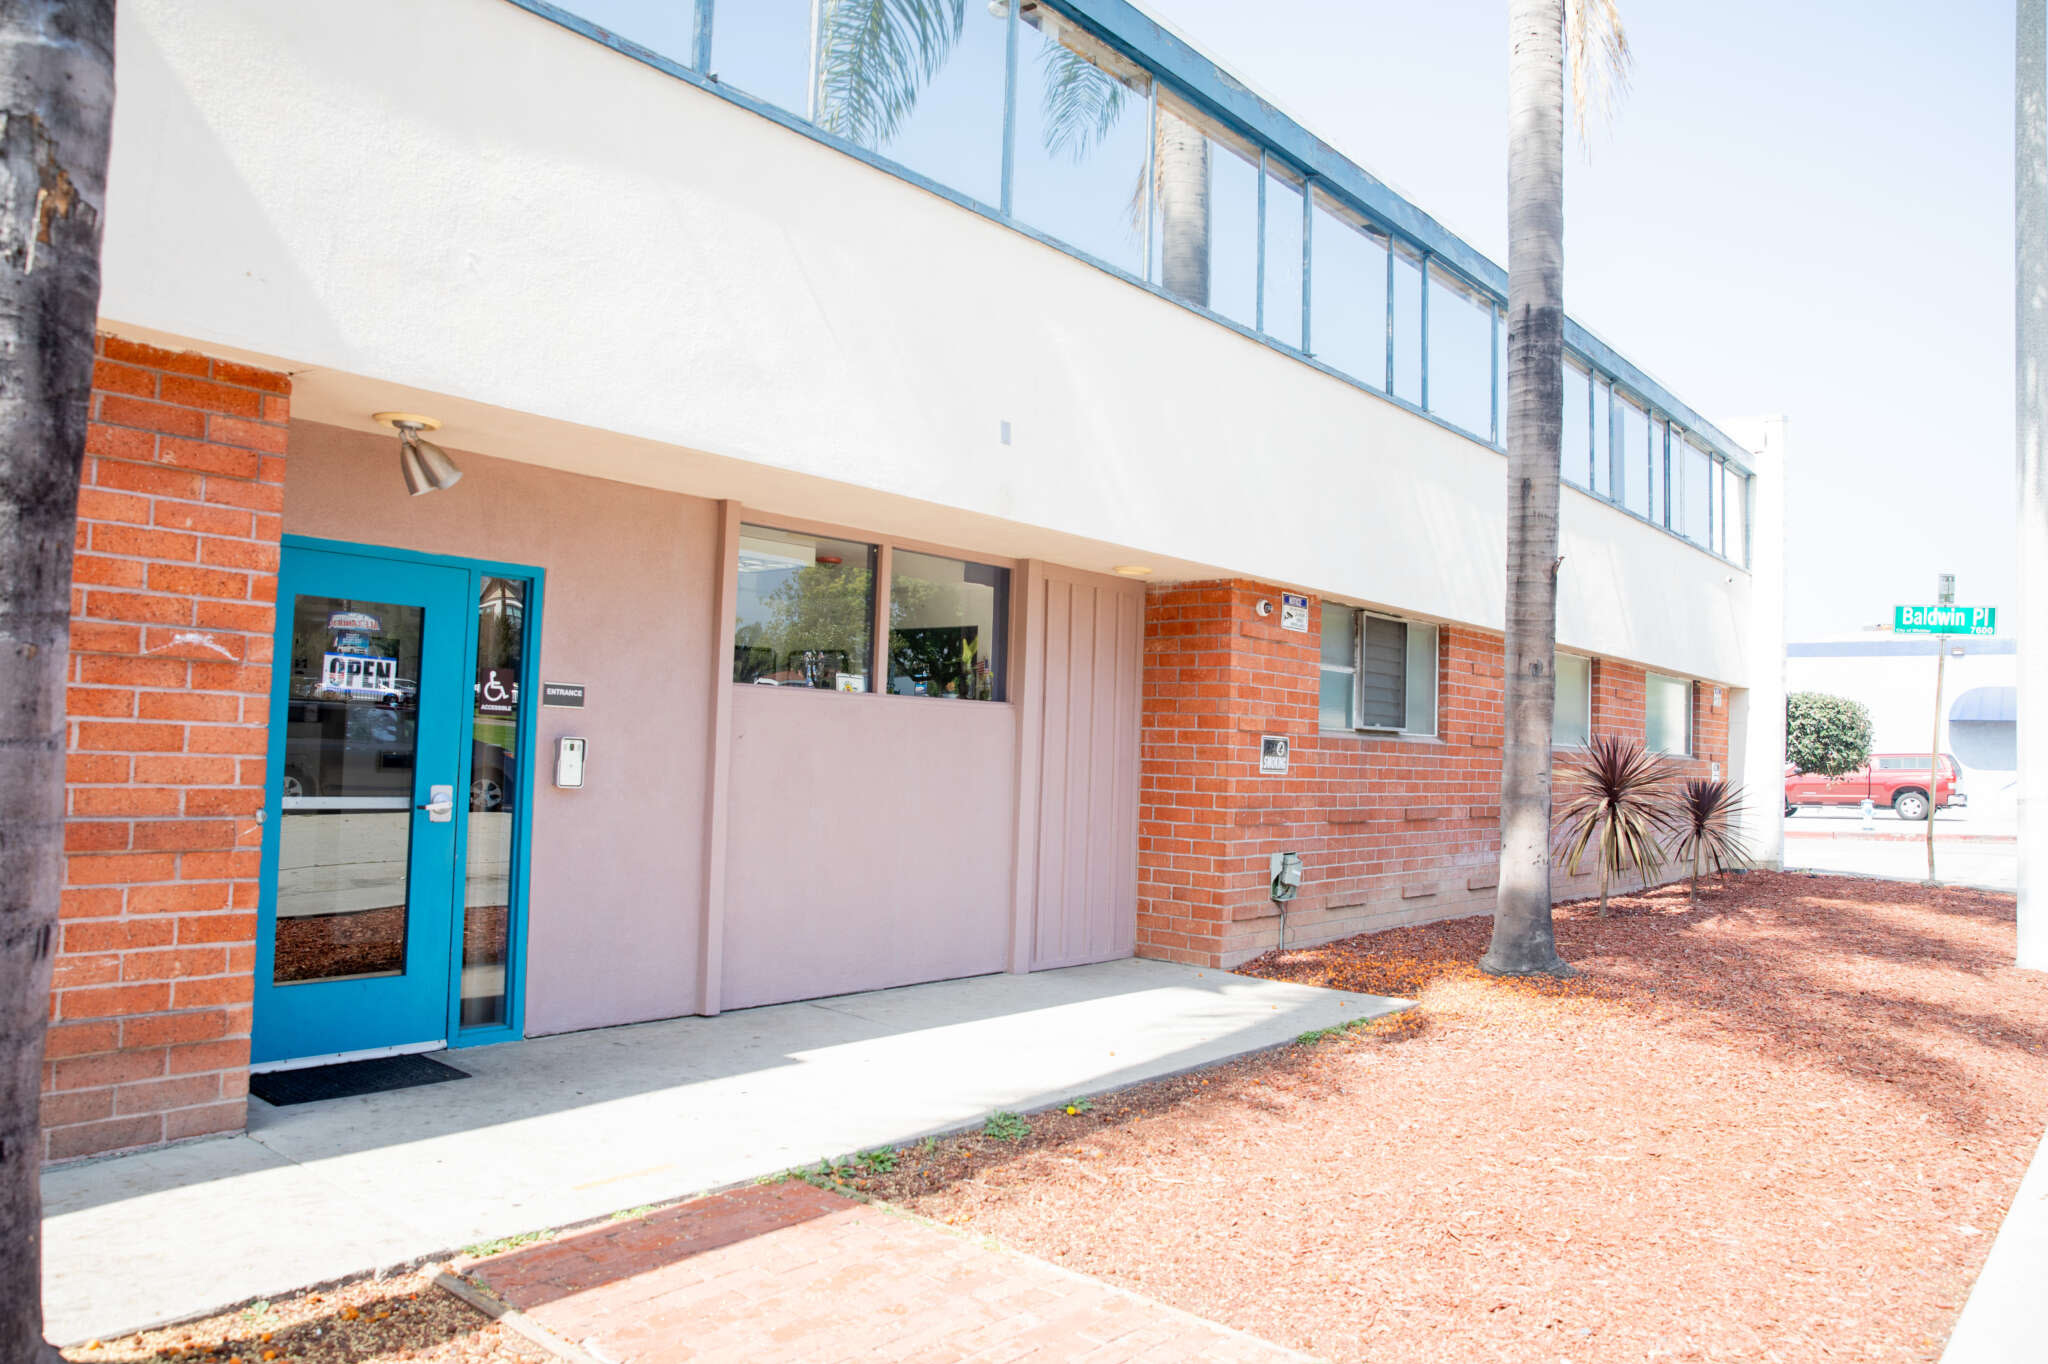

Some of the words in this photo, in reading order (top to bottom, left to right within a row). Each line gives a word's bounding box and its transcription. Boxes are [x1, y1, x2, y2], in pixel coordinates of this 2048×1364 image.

[1902, 607, 1965, 626] Baldwin
[1973, 607, 1989, 627] Pl
[329, 658, 391, 689] OPEN
[546, 688, 583, 697] ENTRANCE
[480, 704, 512, 712] ACCESSIBLE
